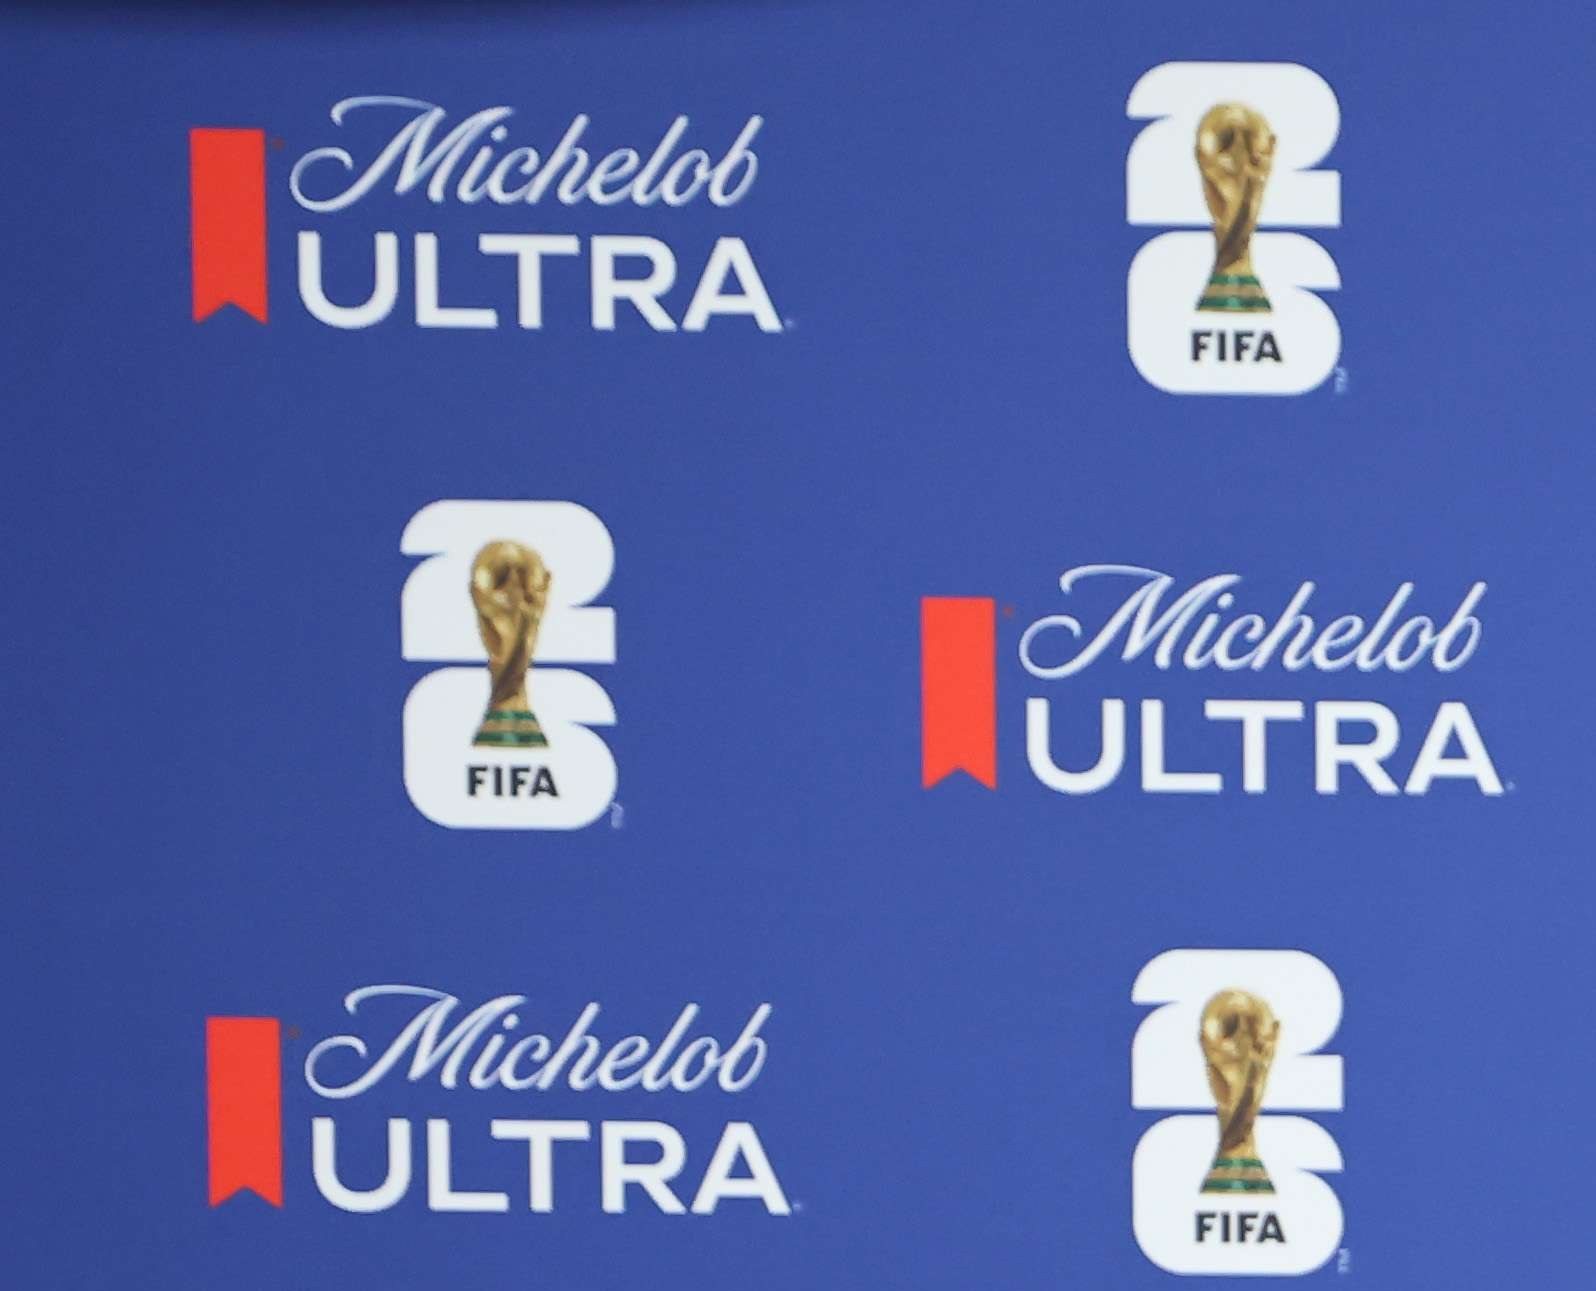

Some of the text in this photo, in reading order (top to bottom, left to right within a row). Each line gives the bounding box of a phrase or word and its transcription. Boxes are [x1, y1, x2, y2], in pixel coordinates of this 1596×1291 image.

[290, 96, 763, 212] Michelob
[298, 231, 783, 332] ULTRA
[1192, 331, 1282, 362] FIFA
[1019, 565, 1486, 678] Michelob
[468, 766, 558, 797] FIFA
[1027, 698, 1504, 796] ULTRA
[305, 985, 772, 1098] Michelob
[312, 1117, 791, 1215] ULTRA
[1196, 1213, 1285, 1243] FIFA
